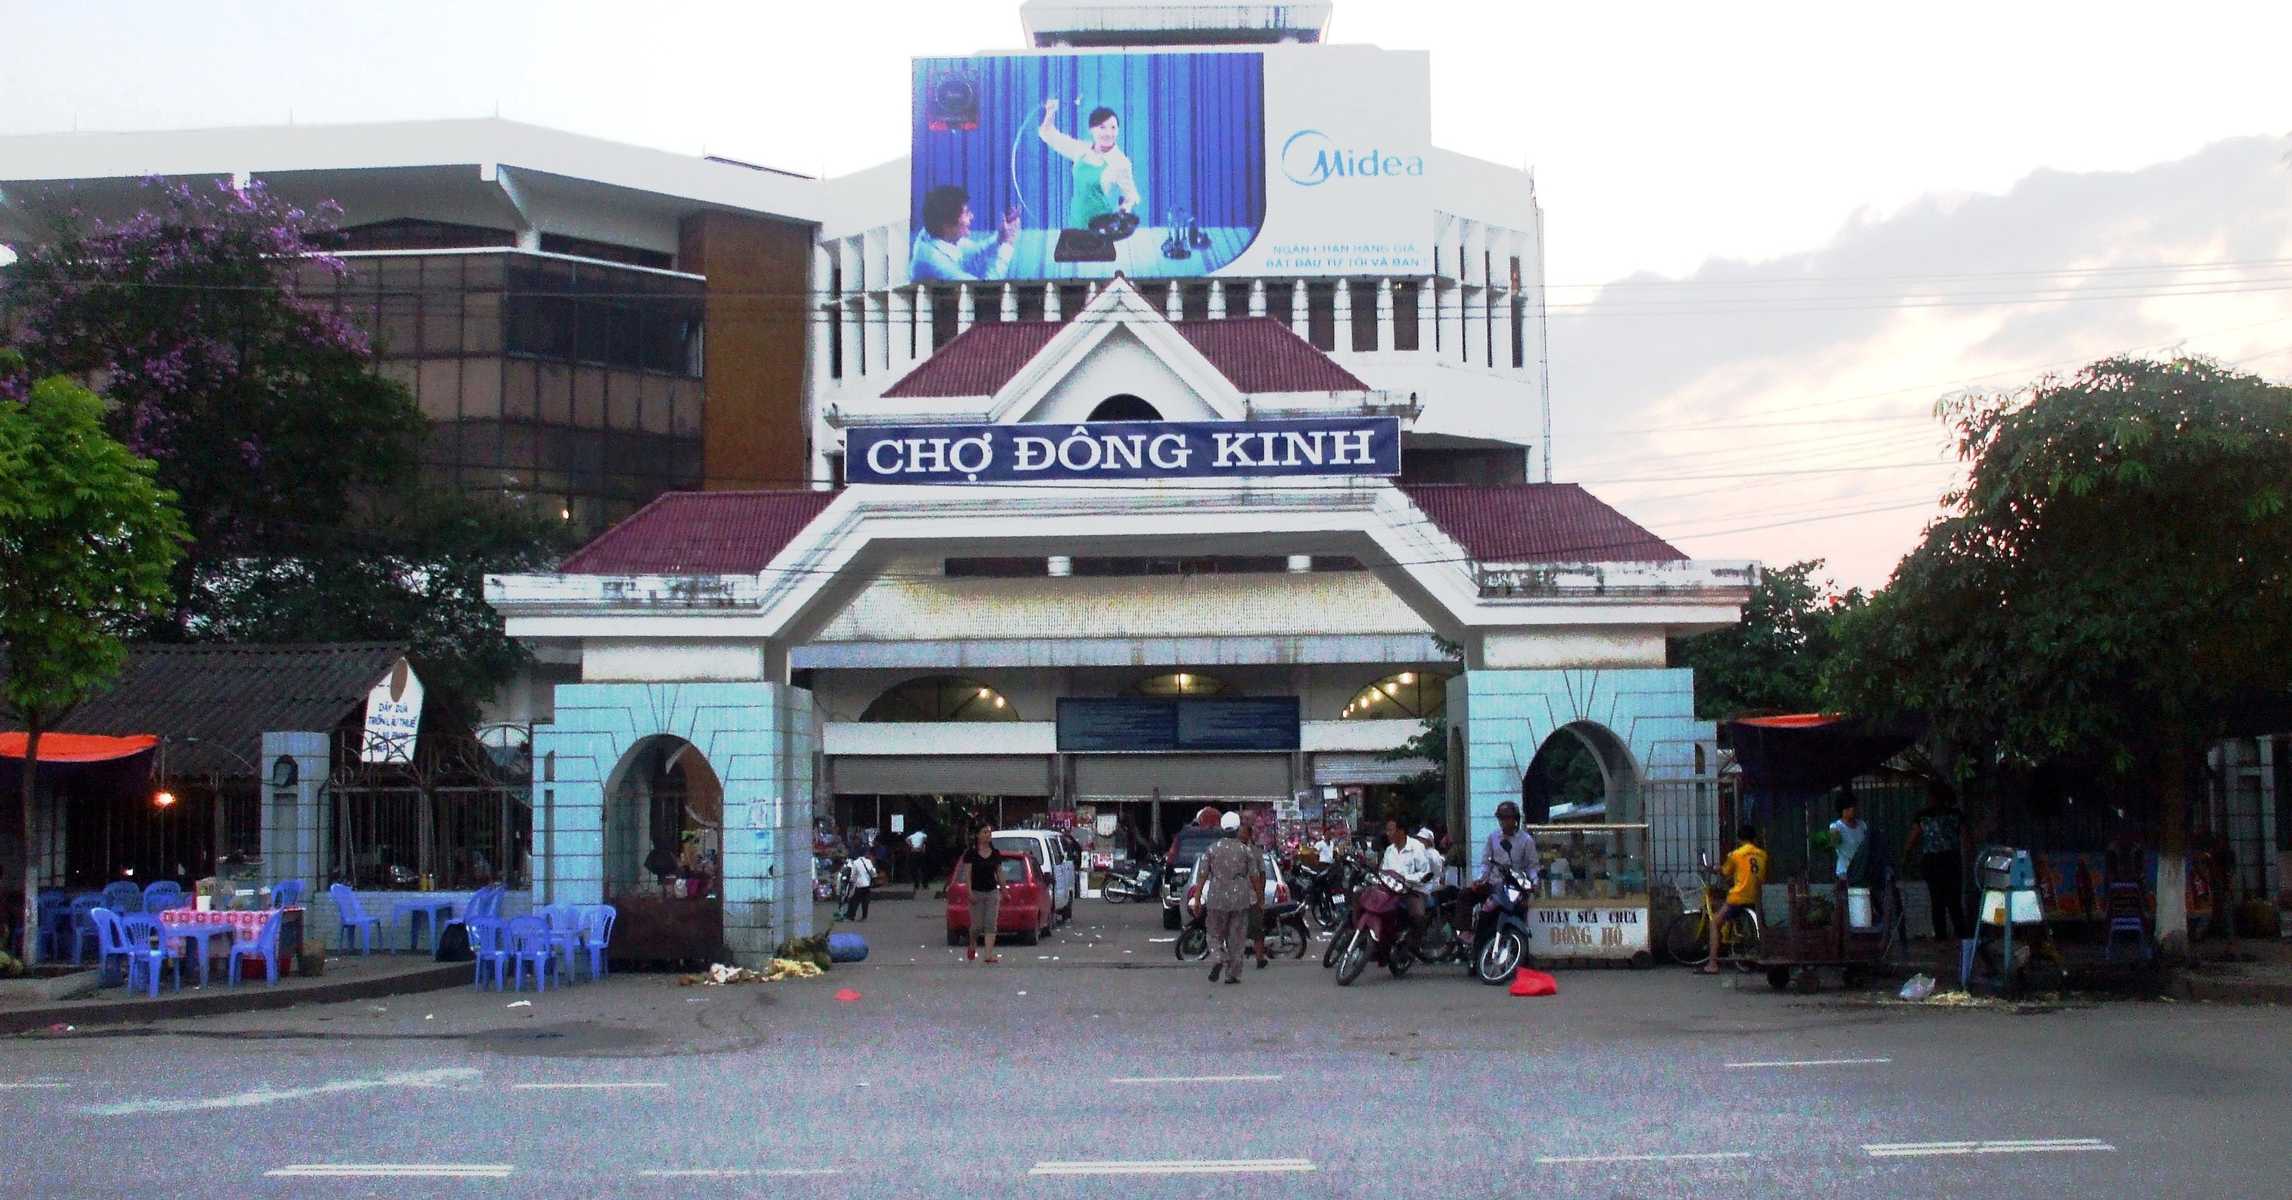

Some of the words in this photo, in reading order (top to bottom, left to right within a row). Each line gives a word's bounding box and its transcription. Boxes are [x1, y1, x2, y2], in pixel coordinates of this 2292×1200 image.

[867, 432, 994, 482] CHỢ
[1013, 425, 1193, 472] ĐÔNG
[1211, 429, 1377, 468] KINH
